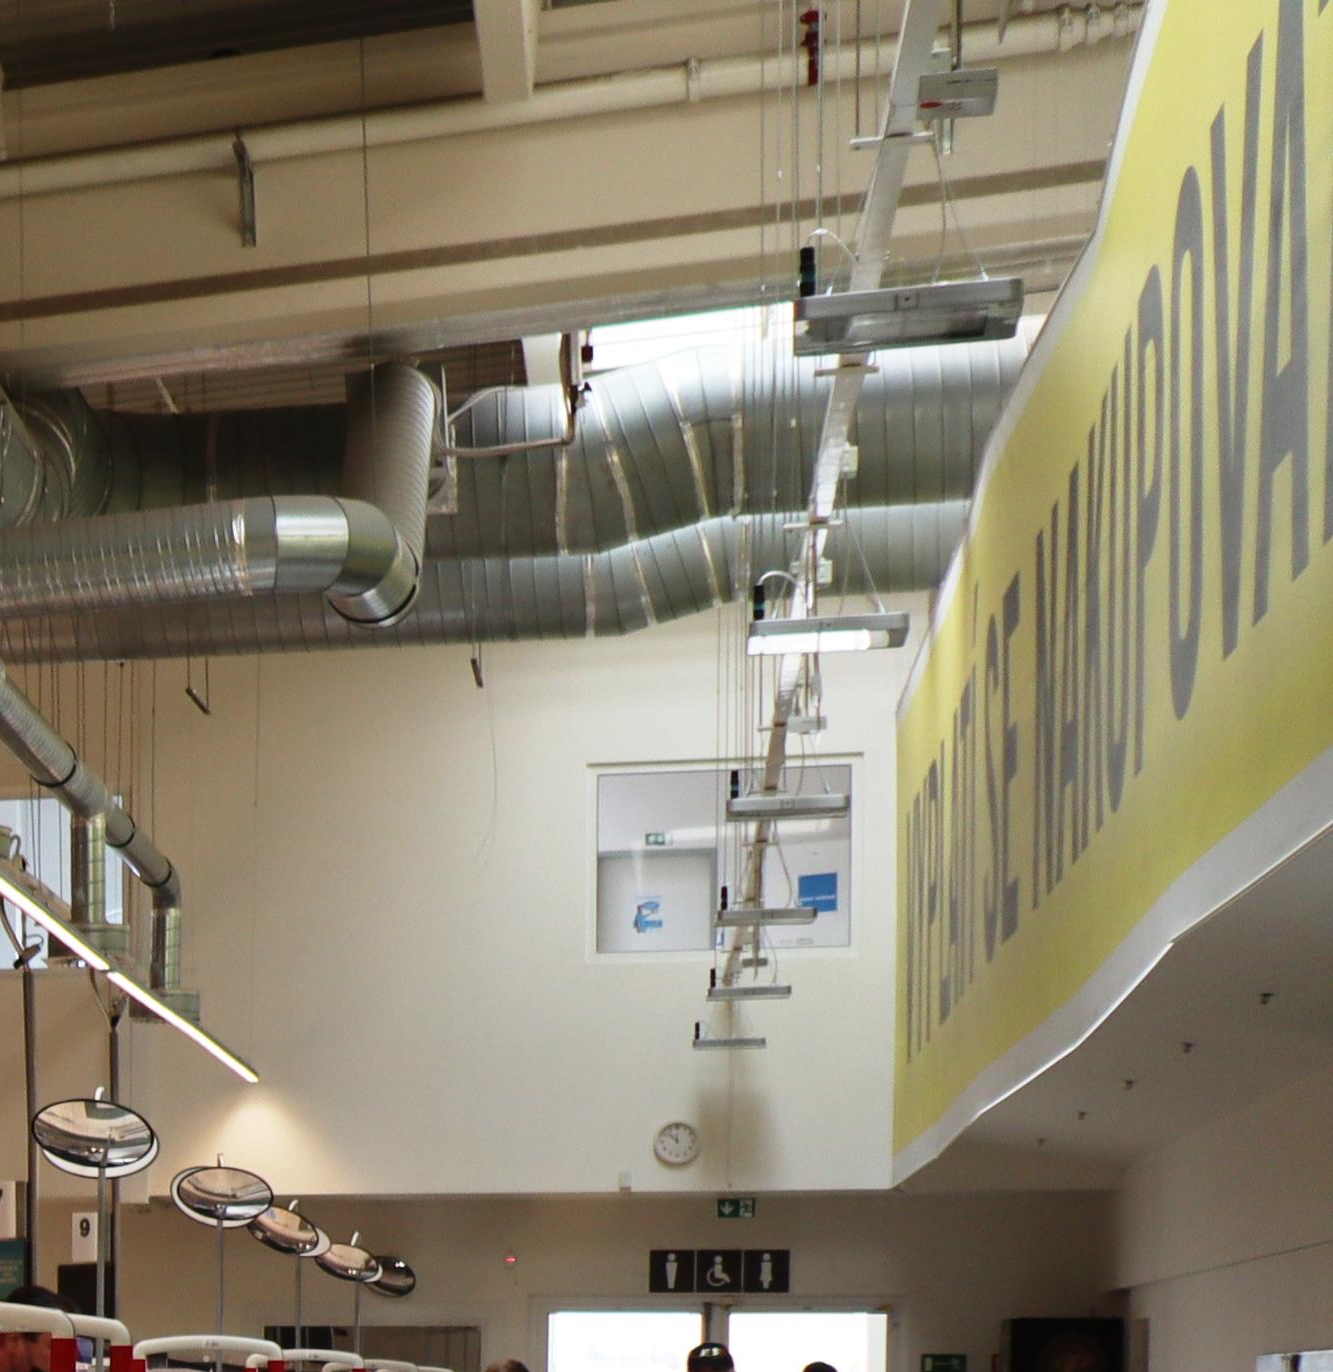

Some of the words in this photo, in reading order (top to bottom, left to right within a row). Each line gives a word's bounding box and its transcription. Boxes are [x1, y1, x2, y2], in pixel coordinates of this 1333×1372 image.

[985, 570, 1020, 965] SE
[1033, 0, 1333, 911] NAKUPOVA
[79, 1217, 91, 1237] 9
